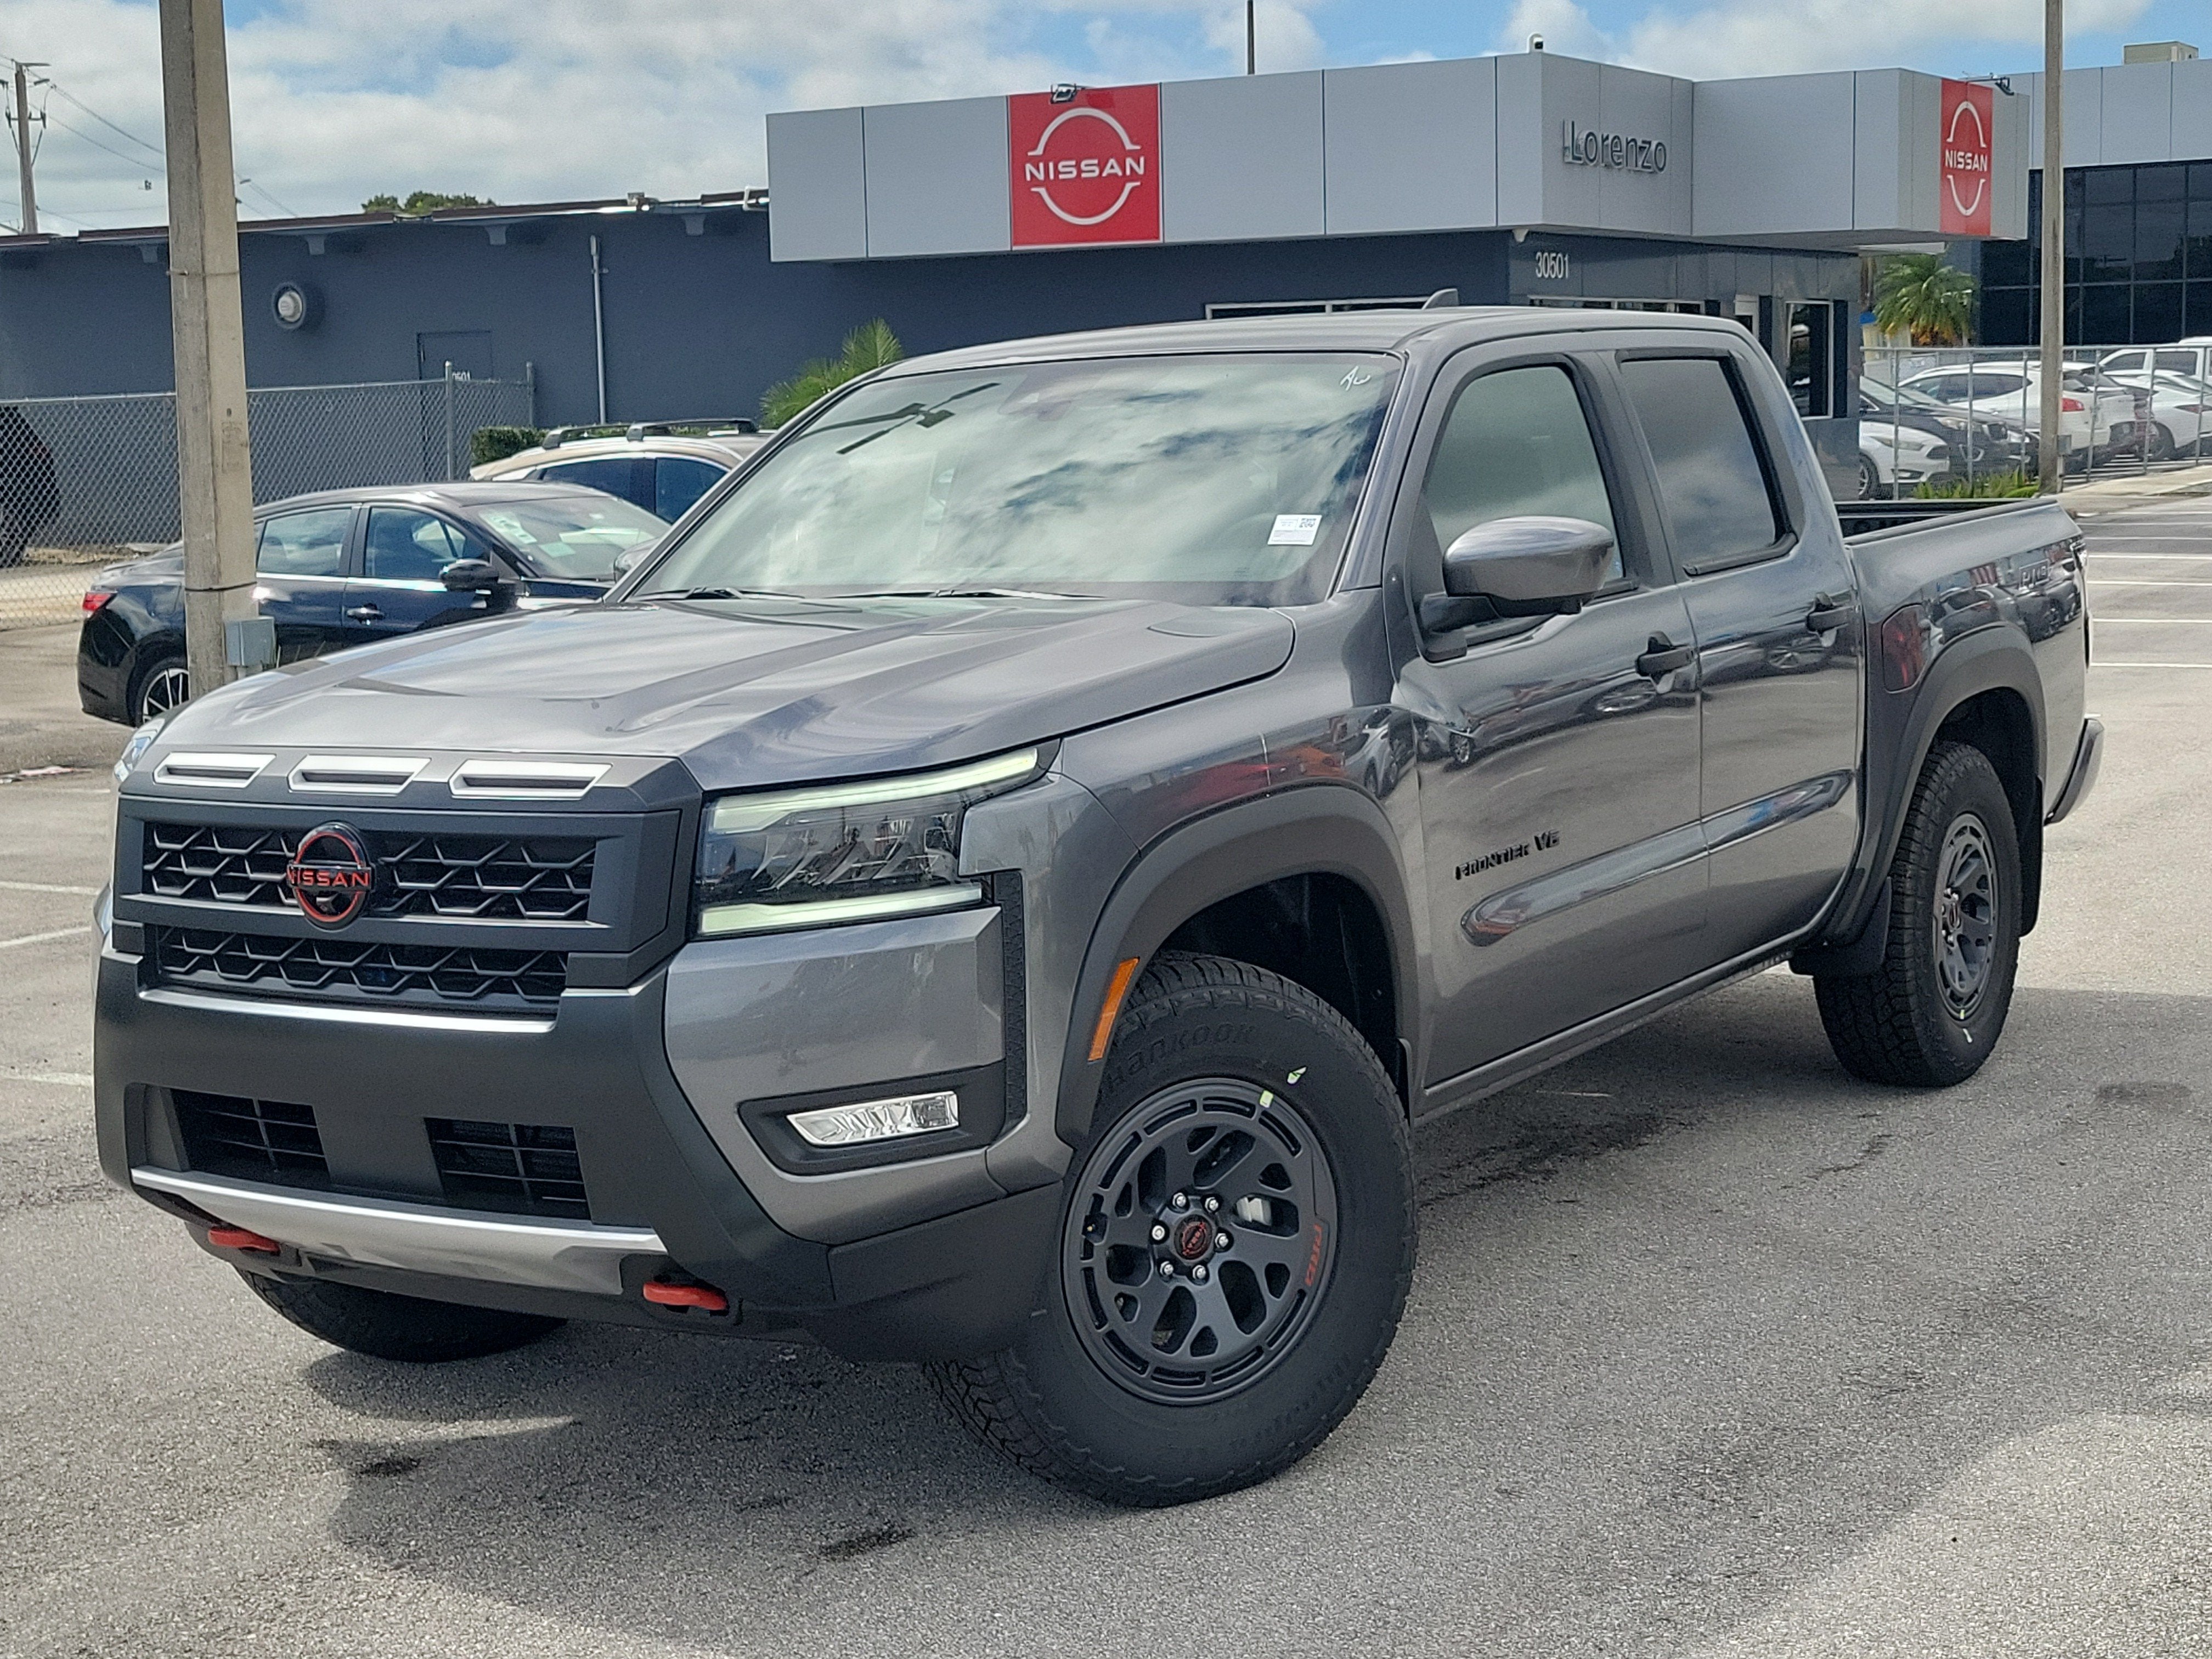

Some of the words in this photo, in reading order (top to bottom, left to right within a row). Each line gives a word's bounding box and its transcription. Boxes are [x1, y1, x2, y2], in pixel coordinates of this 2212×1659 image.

[1563, 119, 1667, 173] Lorenzo
[1025, 156, 1145, 182] NISSAN
[1945, 149, 1988, 172] NISSAN
[1536, 252, 1569, 279] 30501
[1455, 843, 1530, 881] FRONTIER
[1534, 829, 1561, 851] V6
[287, 867, 370, 888] NISSAN
